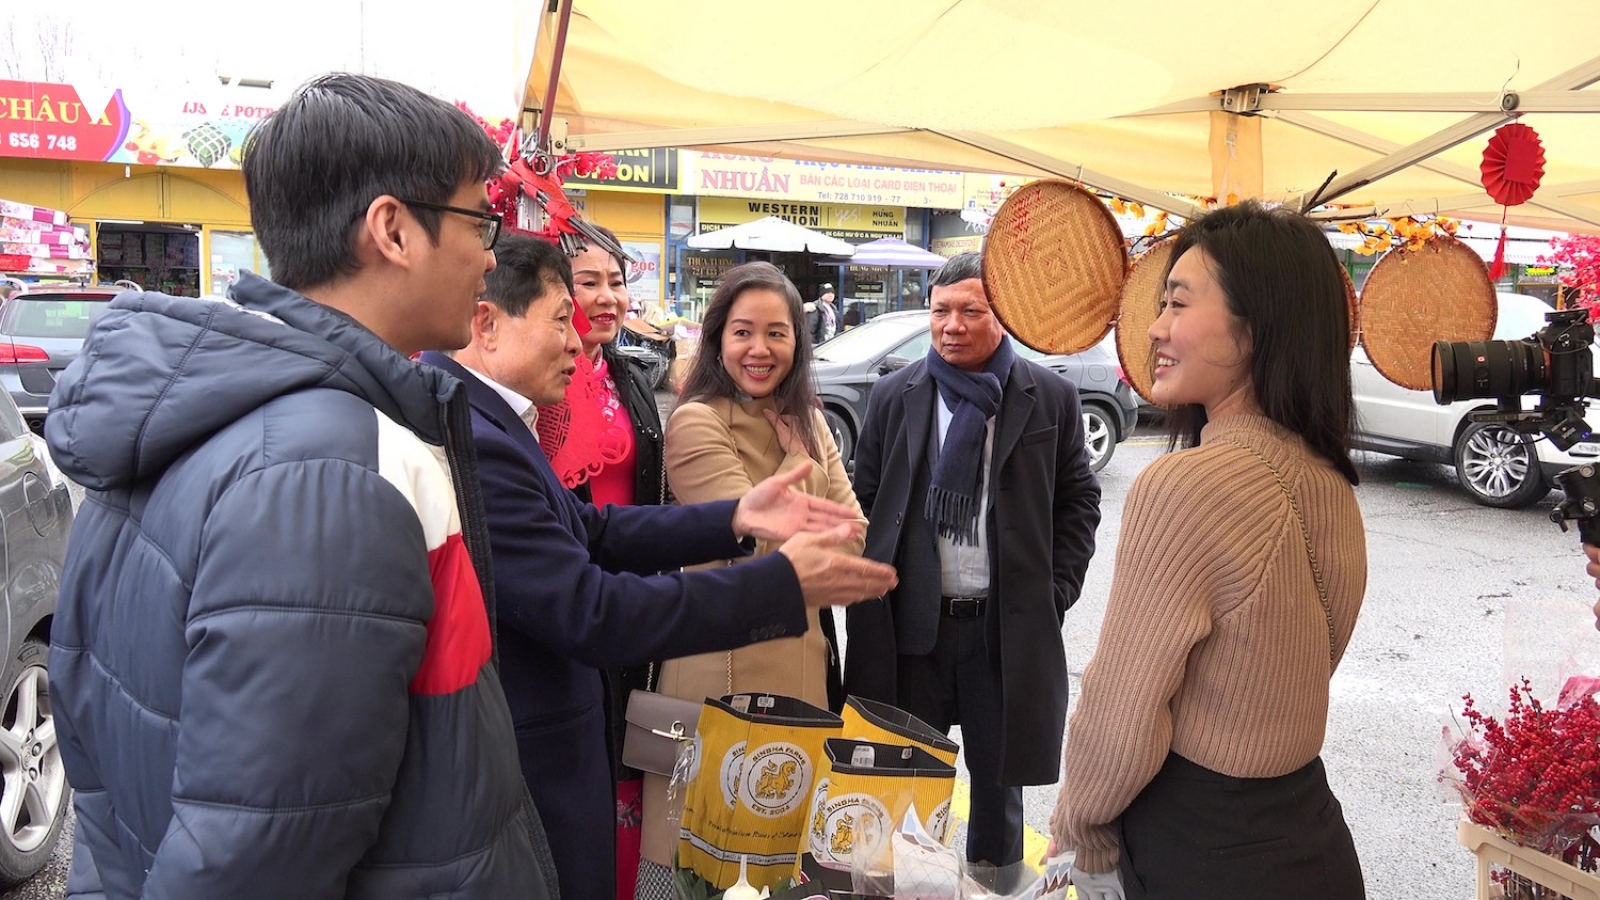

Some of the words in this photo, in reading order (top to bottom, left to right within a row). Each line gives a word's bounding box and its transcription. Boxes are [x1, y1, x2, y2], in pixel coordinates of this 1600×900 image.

[8, 132, 39, 148] 656
[47, 134, 77, 151] 748
[874, 179, 901, 191] CARD
[818, 192, 832, 200] Tel:
[834, 192, 849, 201] 728
[851, 193, 866, 202] 710
[868, 194, 882, 203] 919
[748, 202, 819, 216] WESTERN
[752, 746, 784, 762] SINGHA
[785, 747, 806, 766] FARMS
[751, 803, 767, 815] EST.
[826, 797, 860, 812] SINGHA
